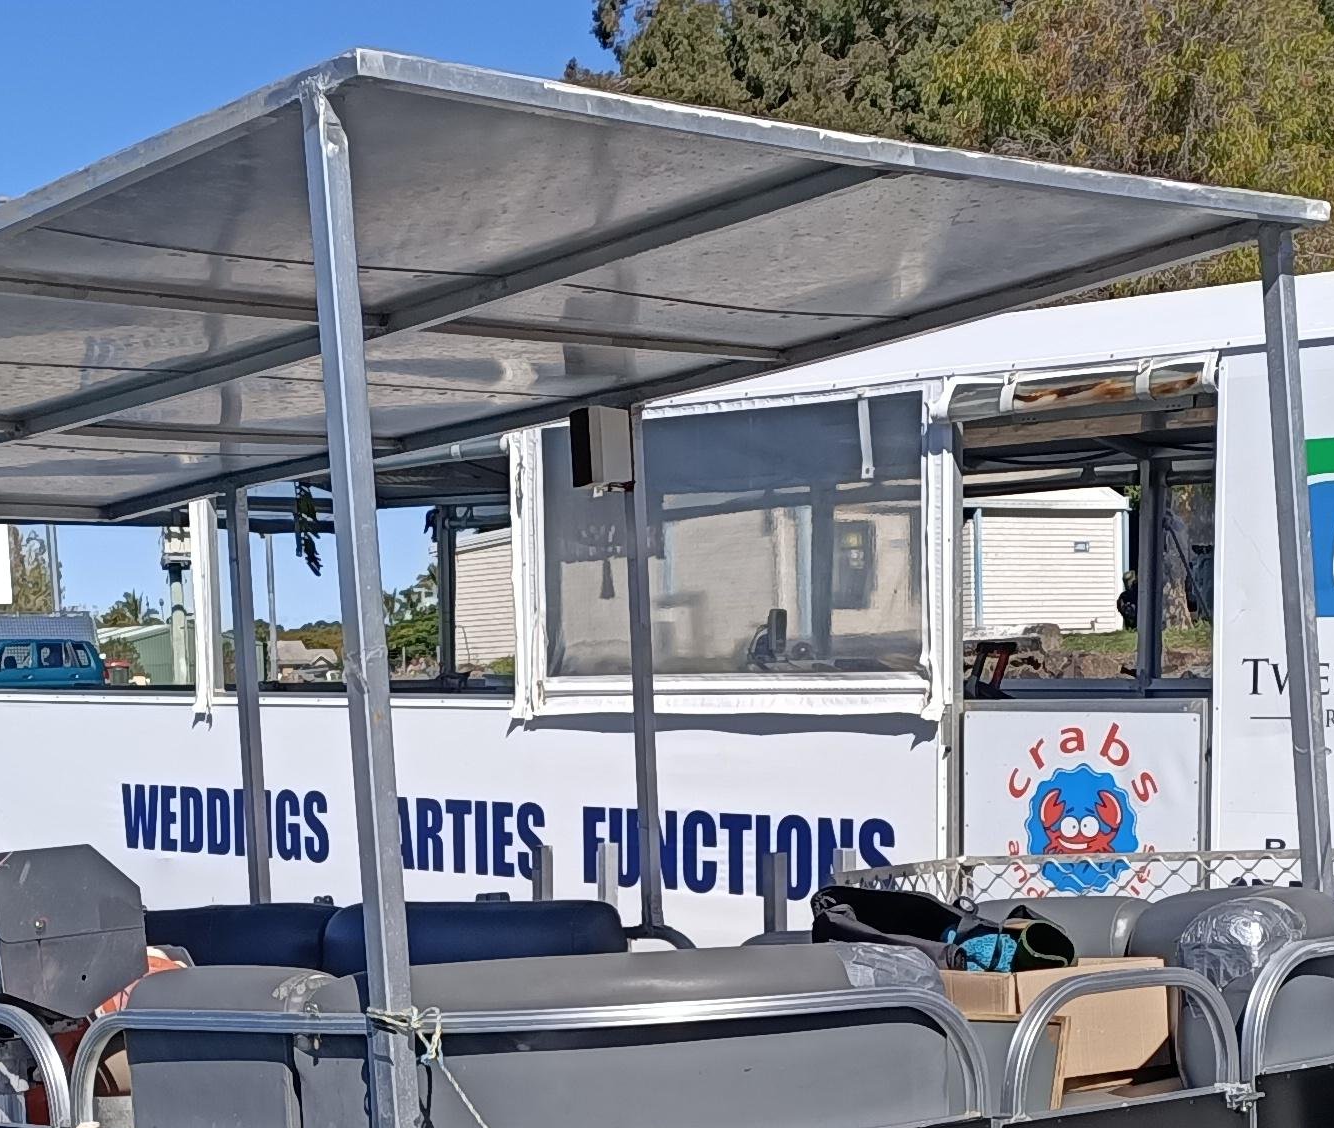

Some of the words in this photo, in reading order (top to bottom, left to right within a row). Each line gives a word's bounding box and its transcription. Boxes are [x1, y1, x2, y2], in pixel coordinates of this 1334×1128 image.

[1009, 722, 1158, 802] crabs
[122, 783, 329, 864] WEDDIGS
[397, 797, 545, 881] ARTIES
